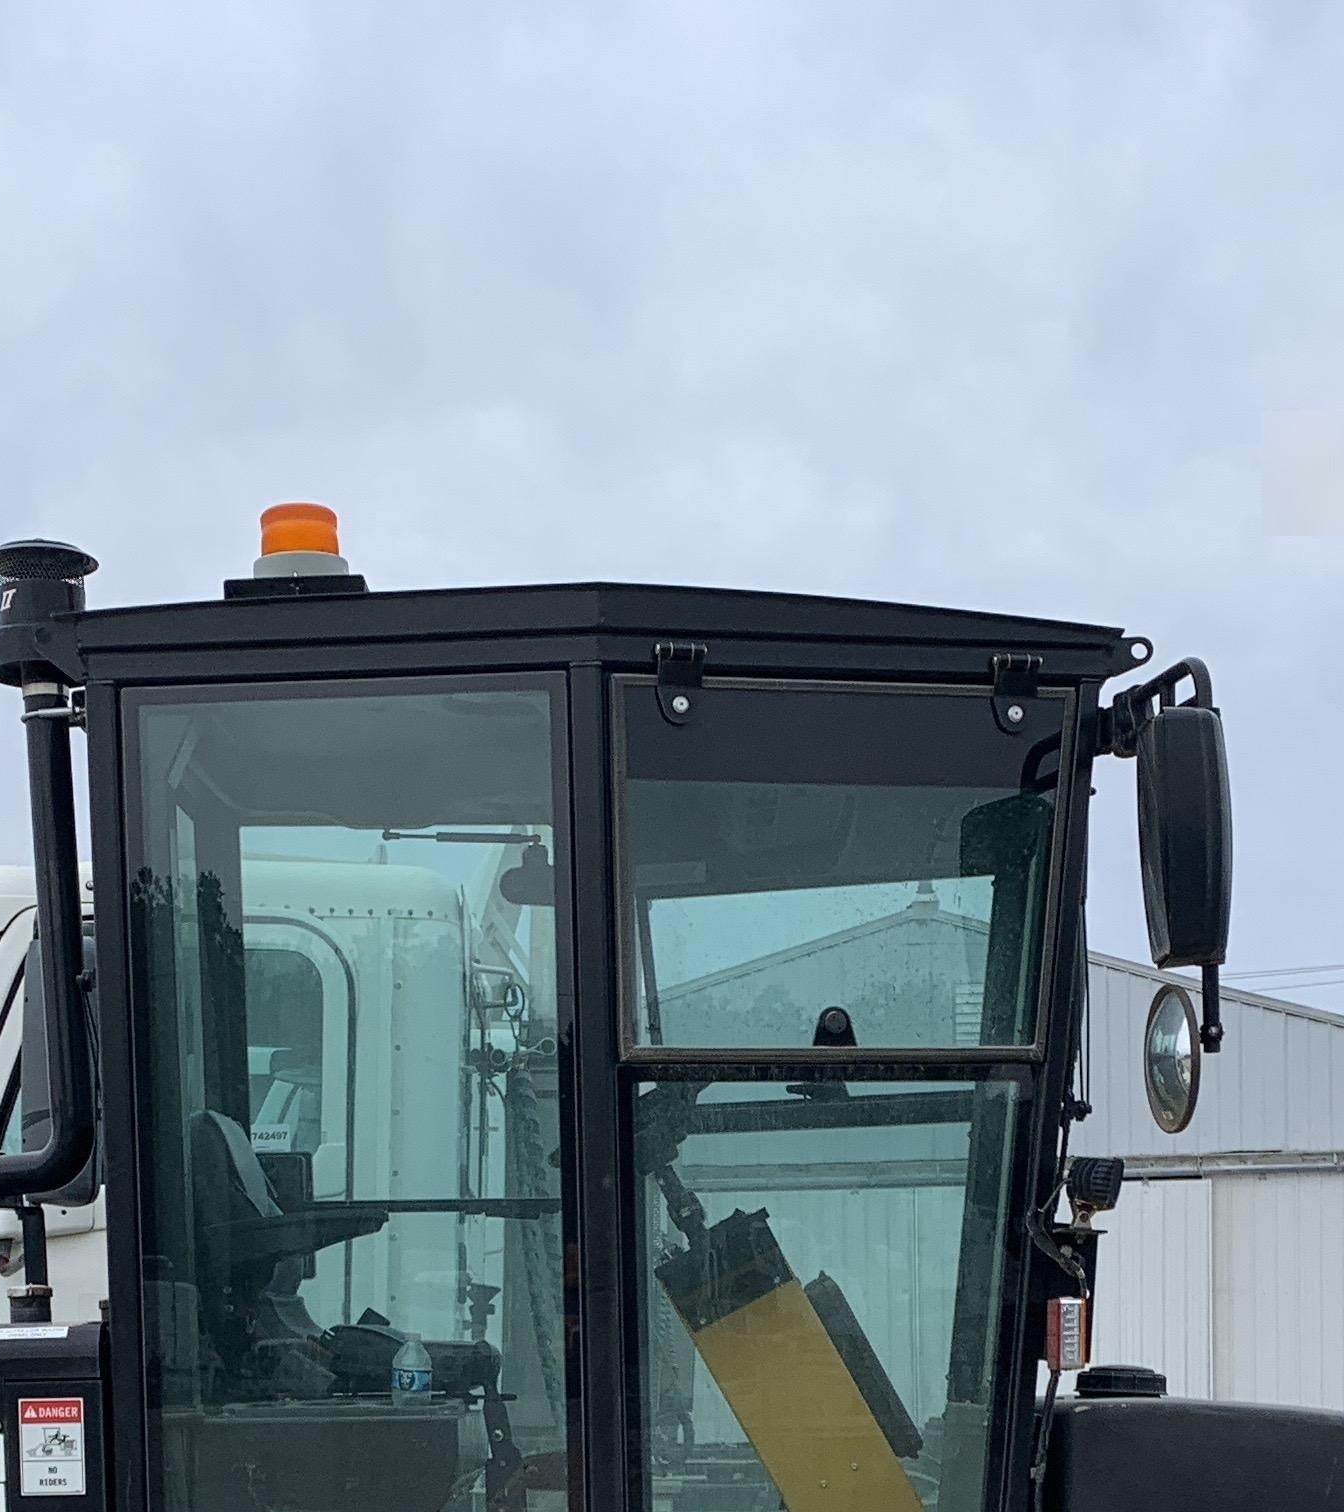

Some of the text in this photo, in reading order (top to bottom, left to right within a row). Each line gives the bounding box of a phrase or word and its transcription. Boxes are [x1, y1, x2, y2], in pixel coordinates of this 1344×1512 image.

[38, 1406, 79, 1419] DANGER
[48, 1466, 58, 1474] NO
[39, 1478, 68, 1487] RIDERS
